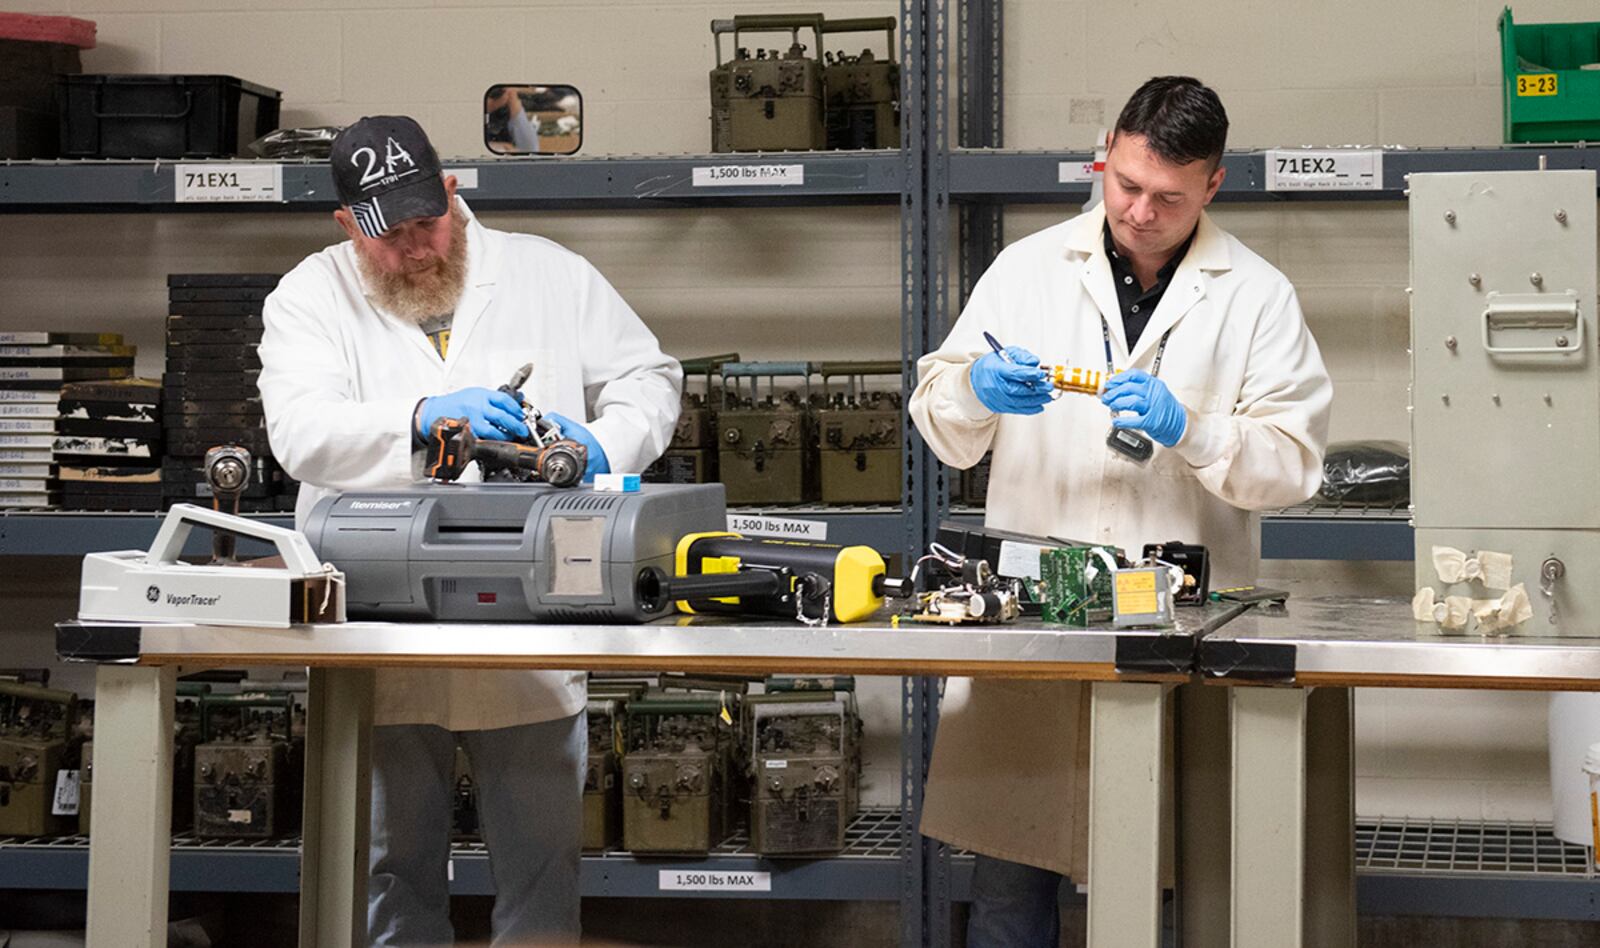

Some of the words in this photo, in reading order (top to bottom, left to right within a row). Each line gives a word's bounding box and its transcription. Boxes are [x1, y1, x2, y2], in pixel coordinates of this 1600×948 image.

[1519, 77, 1556, 93] 3-23
[350, 136, 415, 186] 2A
[709, 168, 740, 179] 1,500
[741, 167, 757, 178] lbs
[732, 519, 762, 531] 1,500
[764, 520, 781, 532] lbs
[783, 522, 810, 534] MAX
[676, 874, 707, 886] 1,500
[708, 874, 725, 886] lbs
[727, 875, 755, 886] MAX
